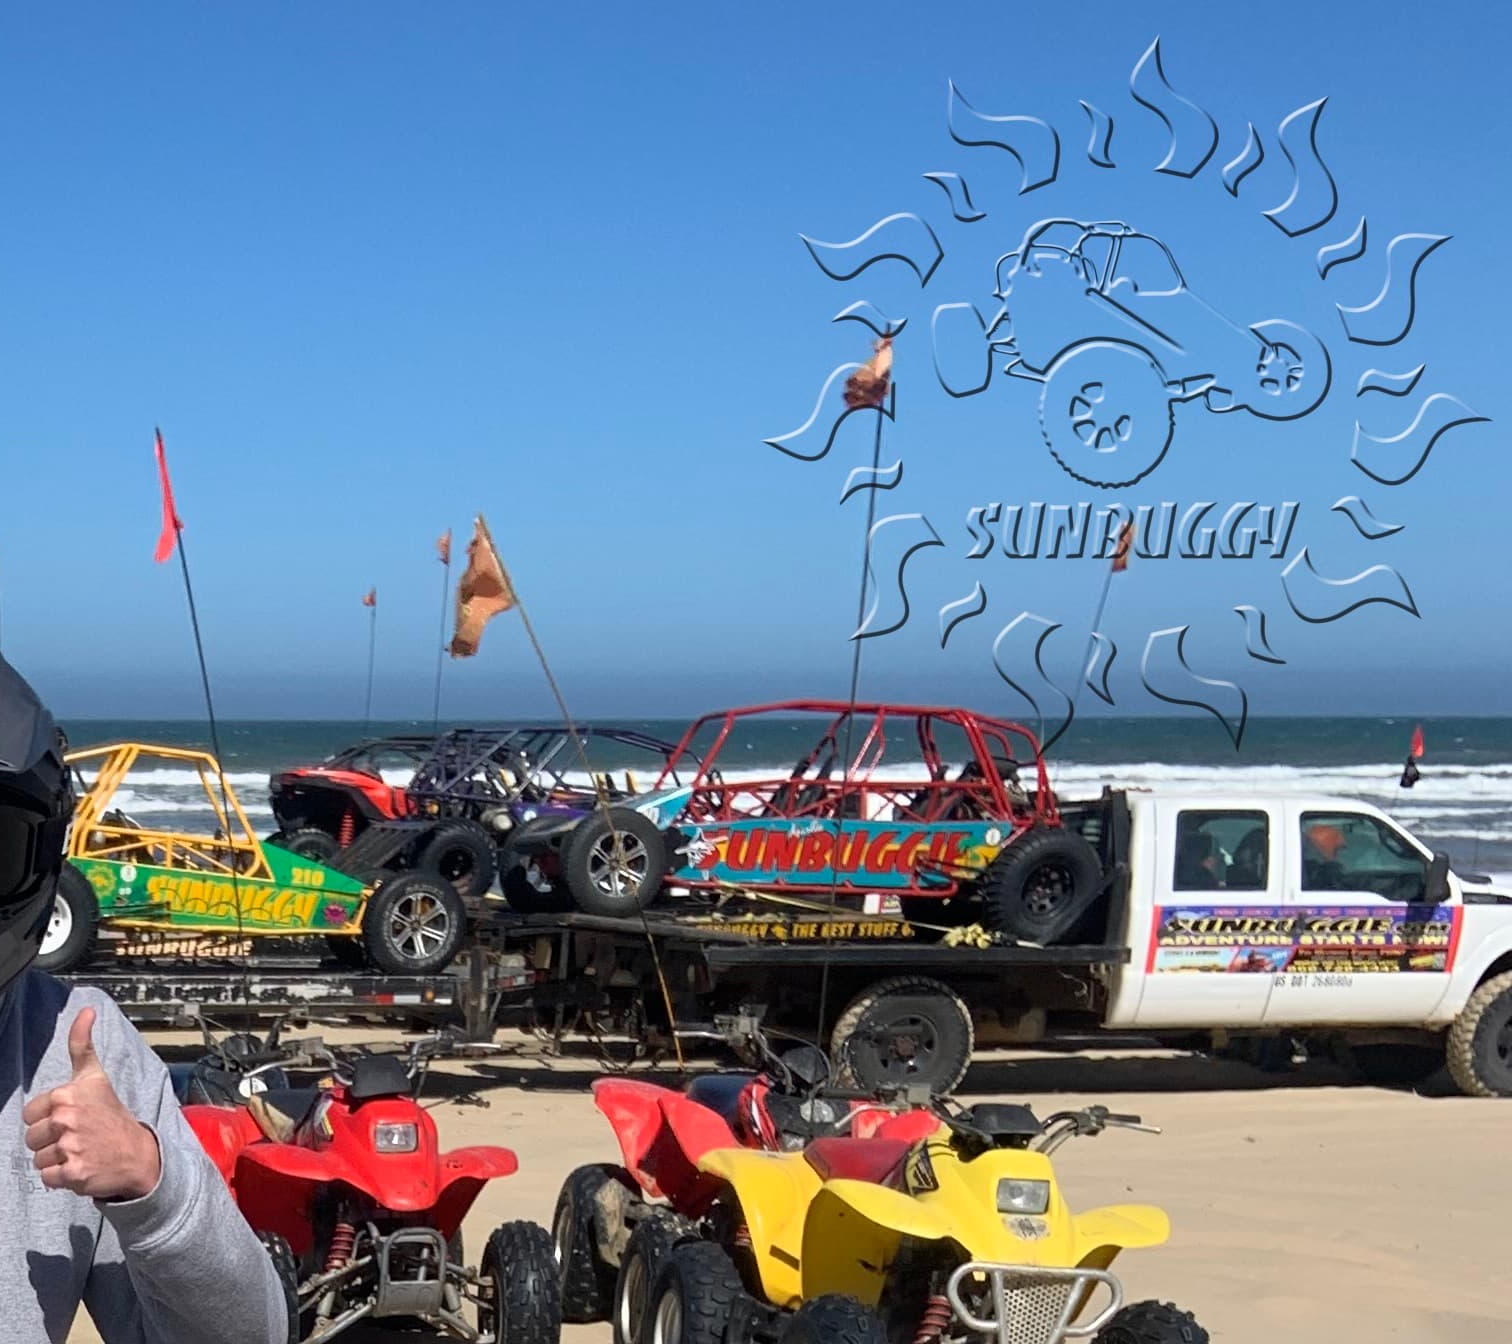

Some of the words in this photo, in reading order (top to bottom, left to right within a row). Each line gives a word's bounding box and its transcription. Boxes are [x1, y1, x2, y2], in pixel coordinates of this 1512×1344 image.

[291, 868, 325, 886] 210
[1159, 935, 1294, 946] ADVENTURE
[1391, 934, 1449, 946] NW!
